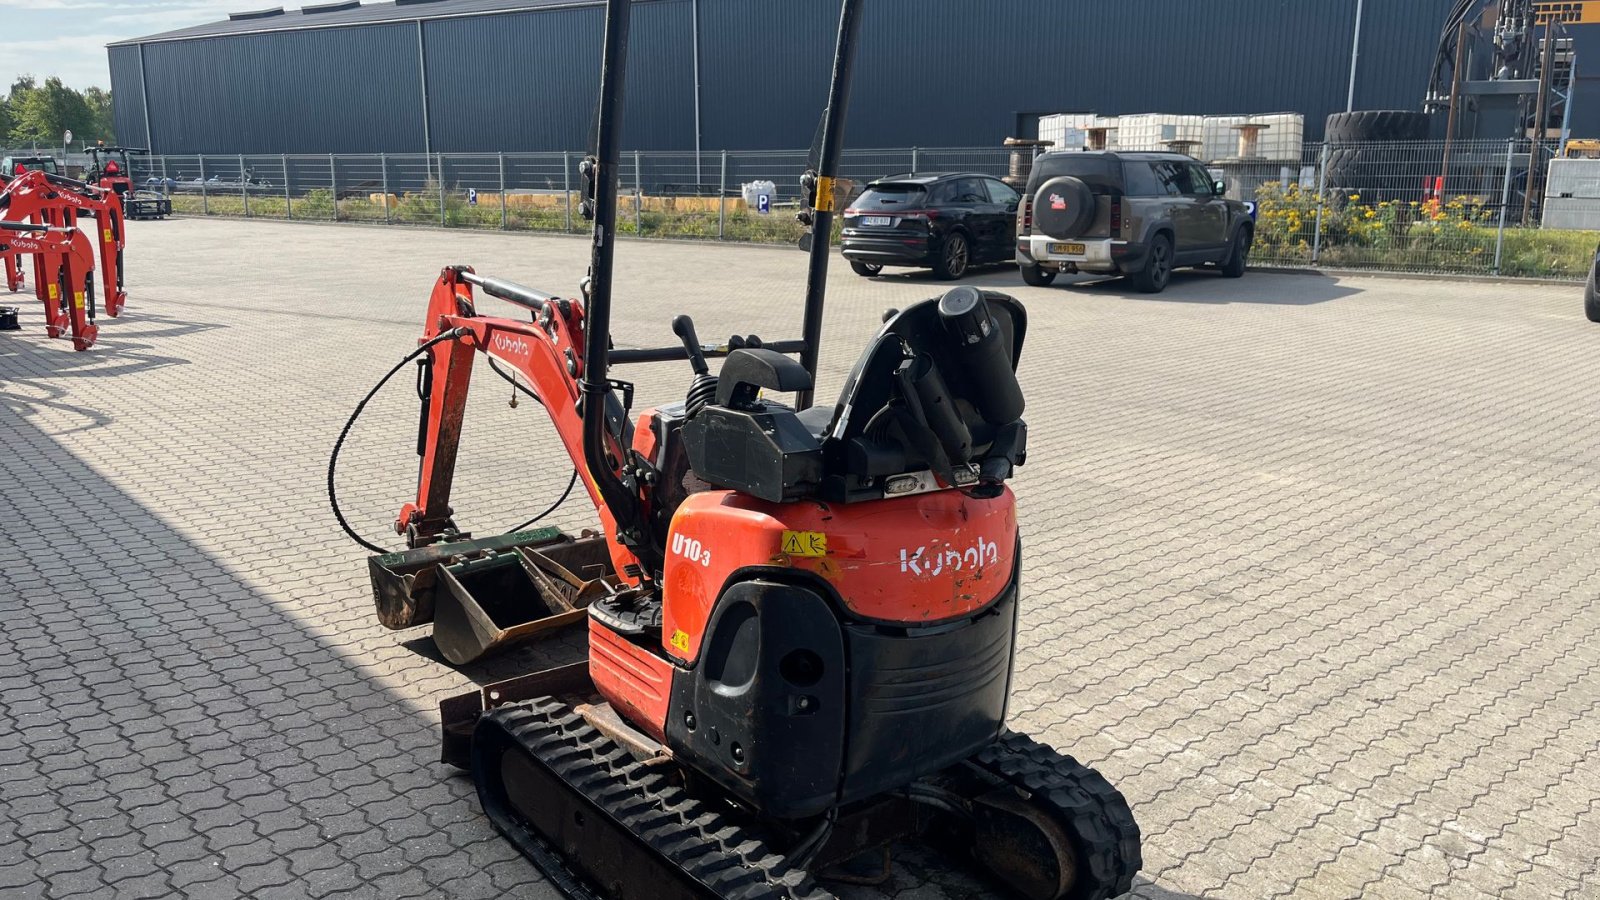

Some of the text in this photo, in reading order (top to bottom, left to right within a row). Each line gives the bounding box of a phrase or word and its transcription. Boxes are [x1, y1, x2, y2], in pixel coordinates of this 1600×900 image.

[57, 190, 82, 204] Kubota
[469, 189, 476, 201] P
[759, 195, 768, 209] P
[10, 239, 38, 250] Kubota
[492, 333, 529, 356] Kubota
